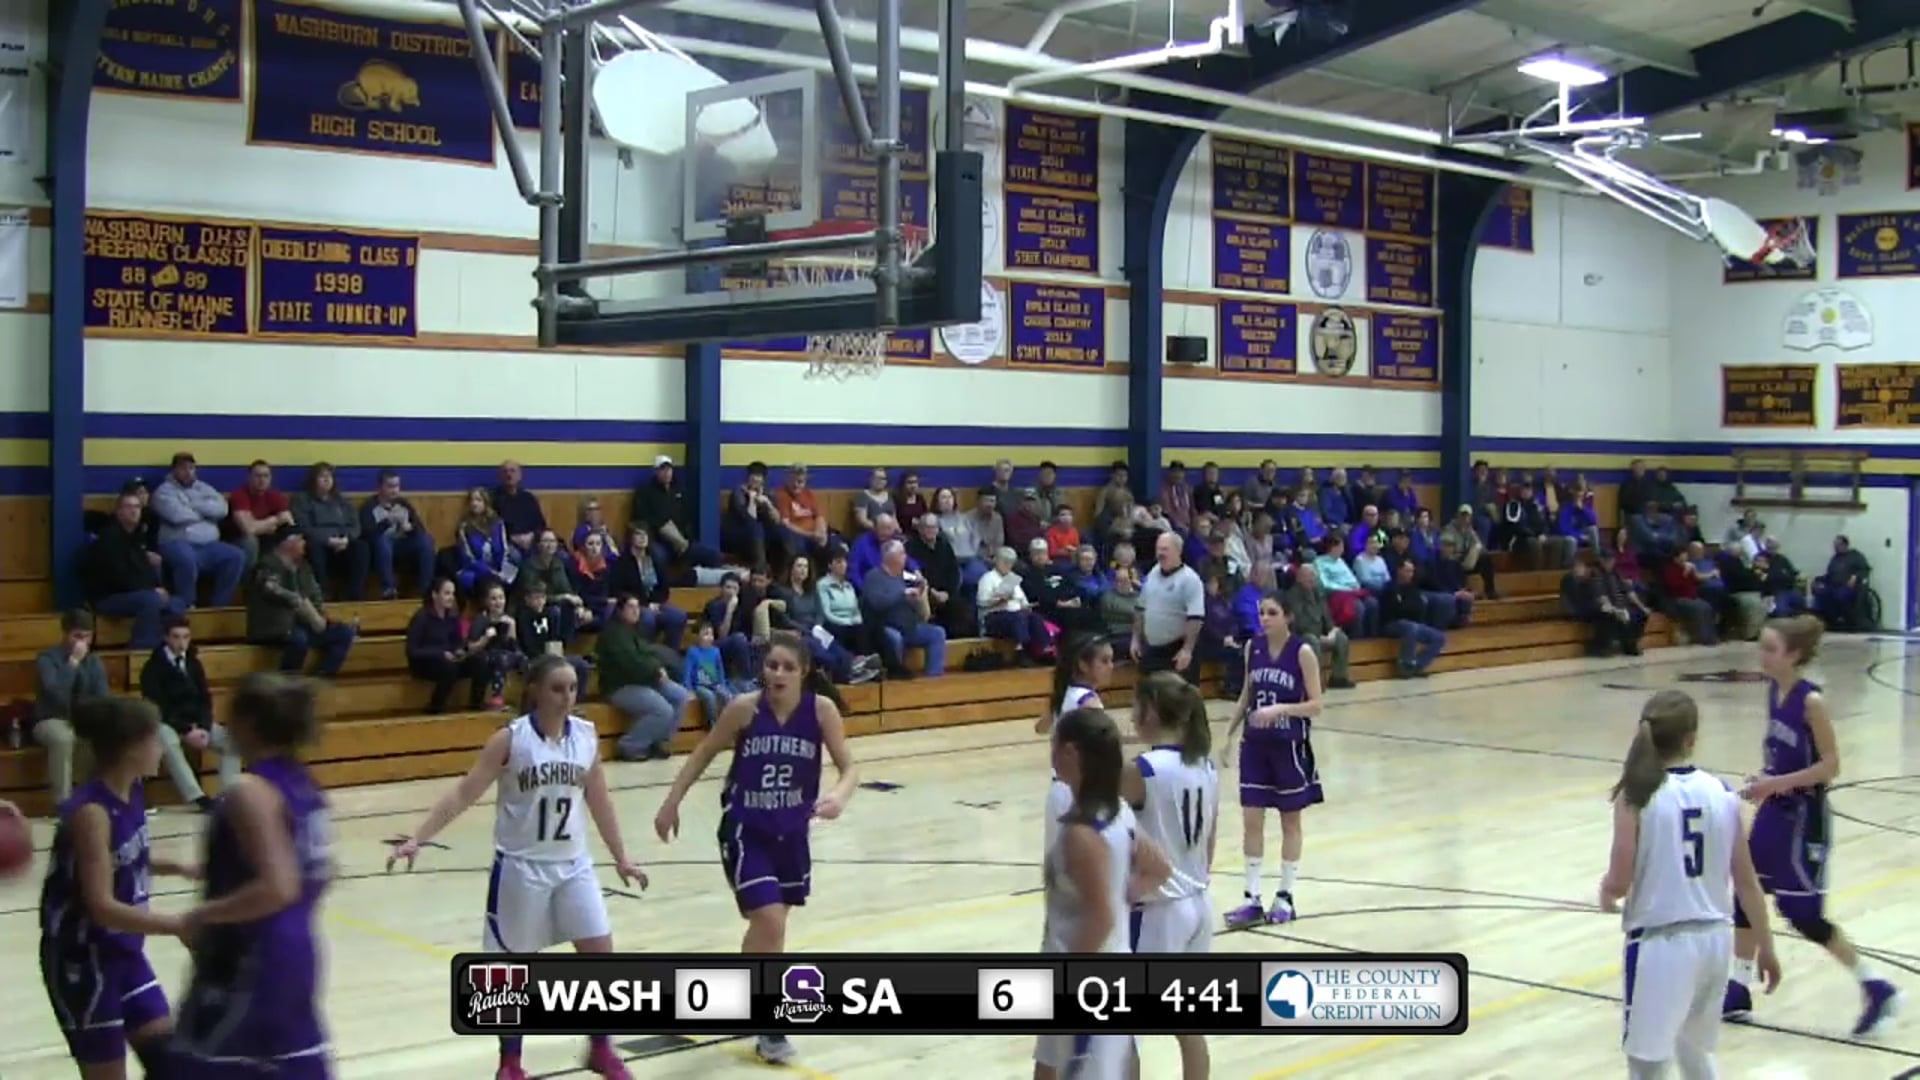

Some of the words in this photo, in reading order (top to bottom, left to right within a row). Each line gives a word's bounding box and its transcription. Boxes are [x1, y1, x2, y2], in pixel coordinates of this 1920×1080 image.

[275, 13, 378, 47] WASHBURN
[391, 31, 475, 58] DISTRICT
[310, 113, 355, 137] HIGH
[368, 120, 441, 146] SCHOOL
[86, 219, 184, 242] WASHBURN
[173, 244, 231, 266] CLASS
[235, 249, 247, 267] D
[360, 246, 399, 266] CLASS
[122, 267, 146, 284] 88
[184, 271, 208, 289] 89
[314, 272, 364, 294] 1998
[93, 288, 145, 309] STATE
[150, 291, 174, 310] OF
[178, 294, 233, 316] MAINE
[268, 301, 313, 322] STATE
[326, 303, 407, 326] RUNNER-UP
[109, 309, 217, 332] RUNNER-UP
[761, 764, 794, 790] 22
[538, 798, 573, 842] 12
[1182, 786, 1203, 850] 11
[1682, 808, 1704, 878] 5
